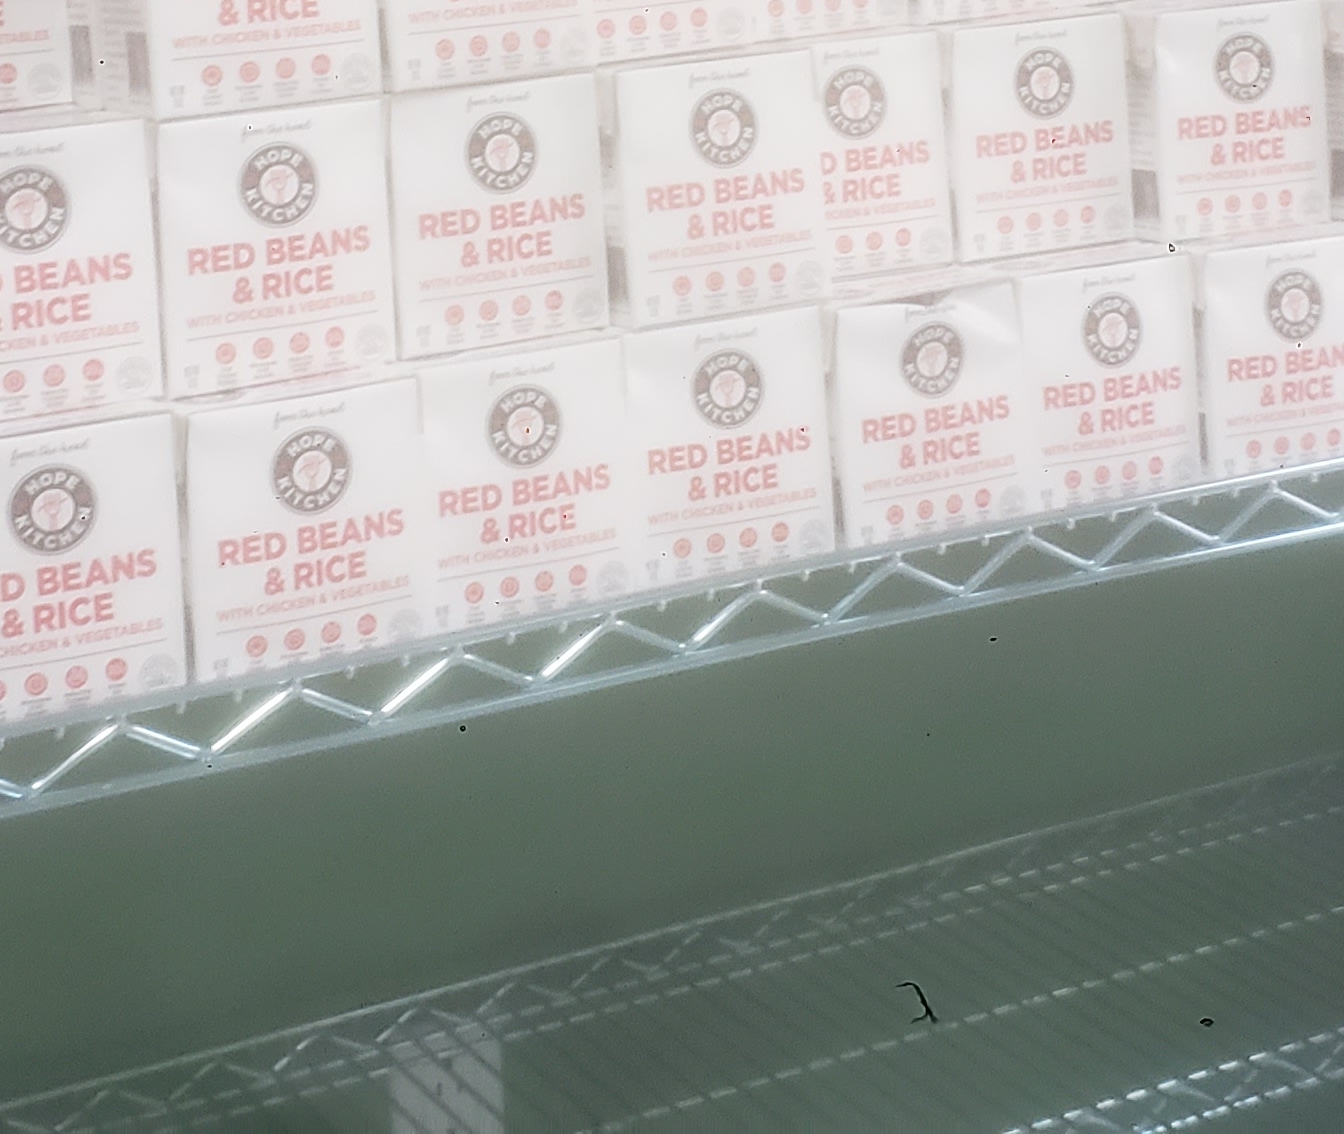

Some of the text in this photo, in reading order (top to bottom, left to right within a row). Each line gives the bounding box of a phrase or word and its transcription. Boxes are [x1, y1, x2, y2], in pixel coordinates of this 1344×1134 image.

[220, 0, 240, 28] &
[1179, 106, 1314, 141] RED BEANS
[1233, 136, 1285, 164] RICE
[419, 195, 587, 240] RED BEANS
[189, 226, 371, 276] RED BEANS
[462, 231, 553, 270] & RICE
[14, 253, 133, 295] BEANS
[234, 265, 333, 305] & RICE
[11, 294, 91, 332] RICE
[1045, 368, 1183, 411] RED BEANS
[1102, 402, 1156, 433] RICE
[24, 470, 79, 496] HOPE
[439, 464, 610, 517] RED BEANS
[14, 505, 91, 551] KITCHEN
[220, 509, 406, 569] RED BEANS
[482, 504, 577, 545] & RICE
[37, 550, 158, 598] BEANS
[266, 551, 365, 597] & RICE
[1, 593, 114, 640] & RICE
